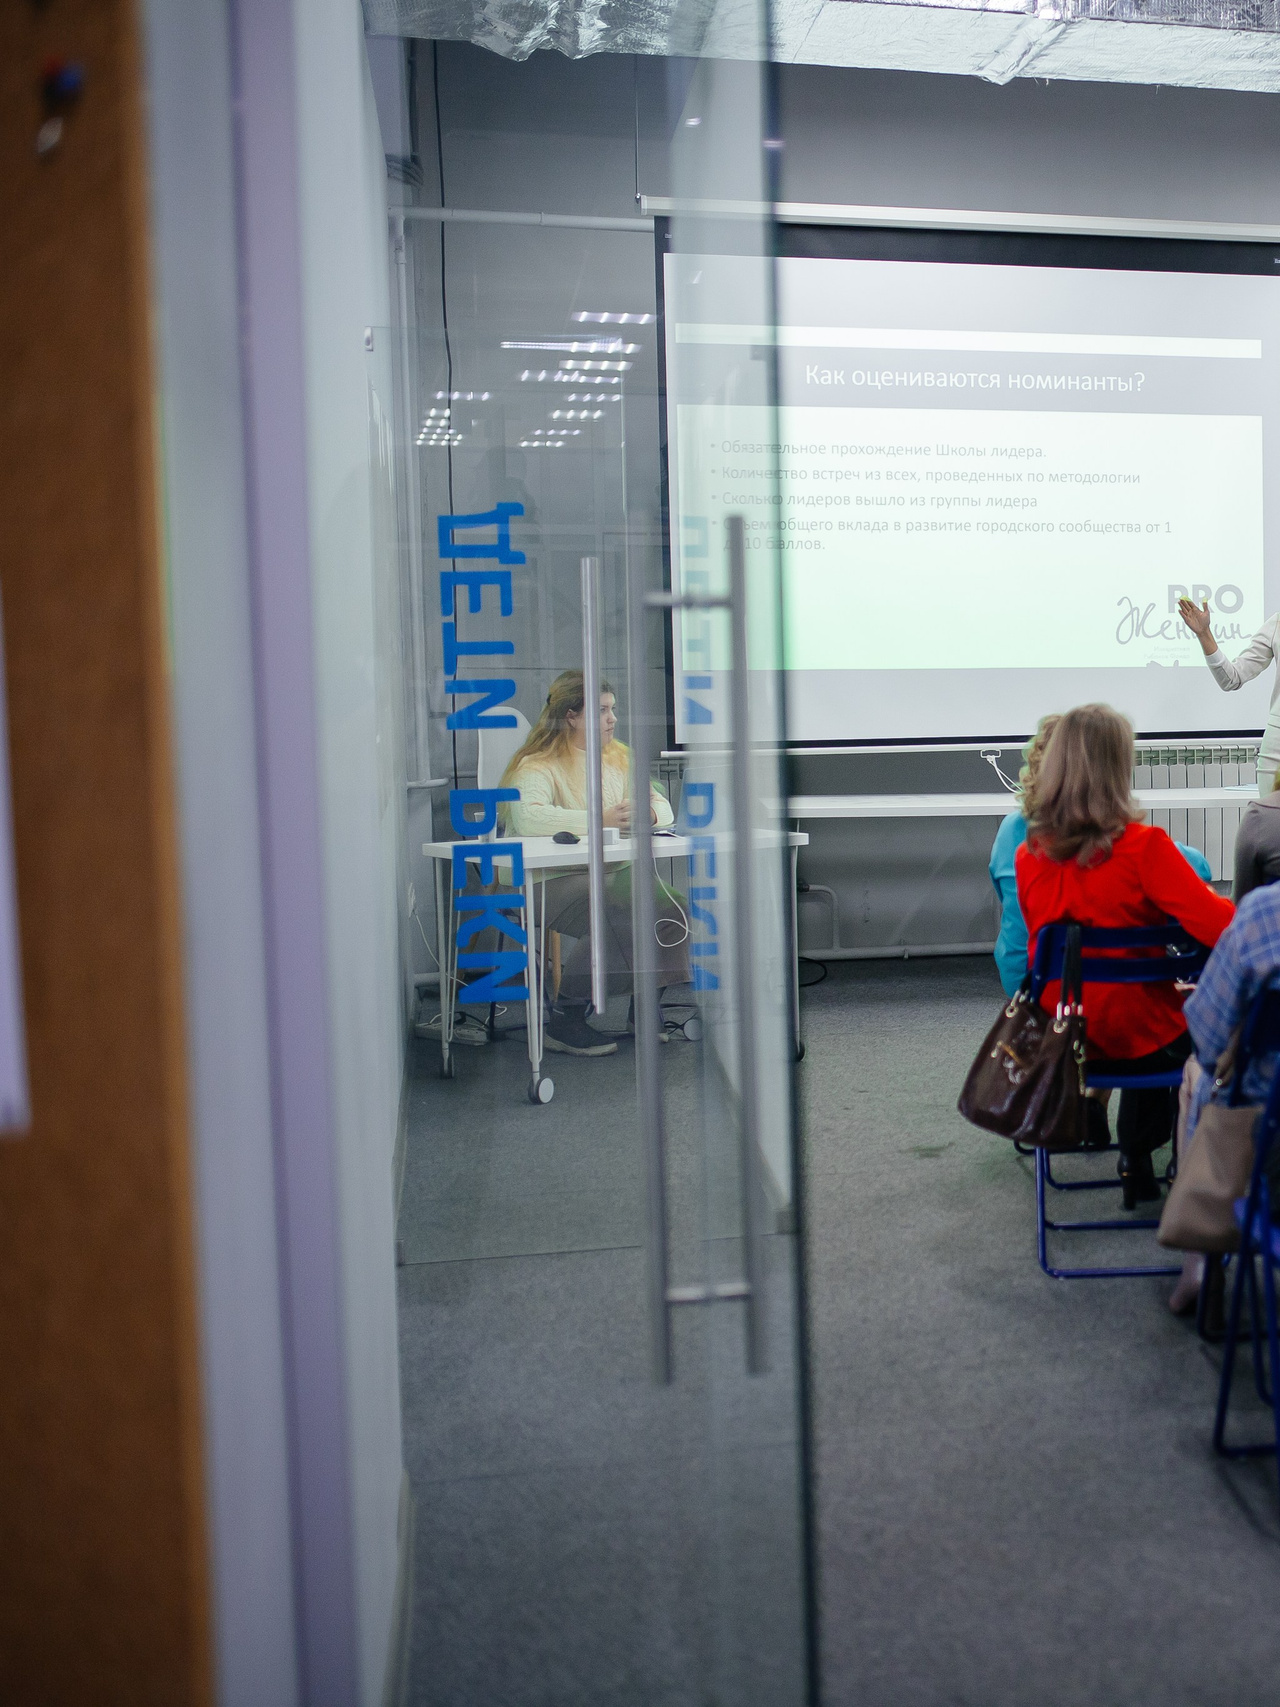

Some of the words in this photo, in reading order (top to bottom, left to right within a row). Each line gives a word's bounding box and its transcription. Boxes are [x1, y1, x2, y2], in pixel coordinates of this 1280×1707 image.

[805, 365, 845, 385] Как
[851, 369, 1001, 389] оцениваются
[1008, 372, 1145, 392] номинанты?
[721, 440, 827, 455] Обязательное
[831, 444, 932, 458] прохождение
[936, 444, 986, 457] Школы
[990, 446, 1047, 460] лидера.
[722, 467, 808, 480] Количество
[813, 469, 860, 482] встреч
[865, 470, 881, 481] из
[885, 470, 921, 482] всех,
[925, 471, 1023, 484] проведенных
[1027, 471, 1045, 483] по
[1048, 473, 1141, 485] методологии
[722, 491, 783, 506] Сколько
[787, 494, 851, 508] лидеров
[856, 495, 906, 506] вышло
[910, 496, 926, 507] из
[930, 496, 981, 509] группы
[985, 497, 1038, 510] лидера
[723, 517, 771, 531] Оъем
[777, 517, 833, 533] общего
[839, 520, 889, 533] вклада
[893, 520, 902, 531] в
[906, 520, 972, 534] развитие
[976, 521, 1055, 535] городского
[1059, 519, 1141, 535] сообщества
[1145, 522, 1161, 533] от
[1164, 521, 1172, 533] 1
[745, 537, 761, 550] 10
[766, 537, 825, 550] баллов.
[1167, 584, 1244, 614] PRO
[1116, 596, 1252, 645] Женин
